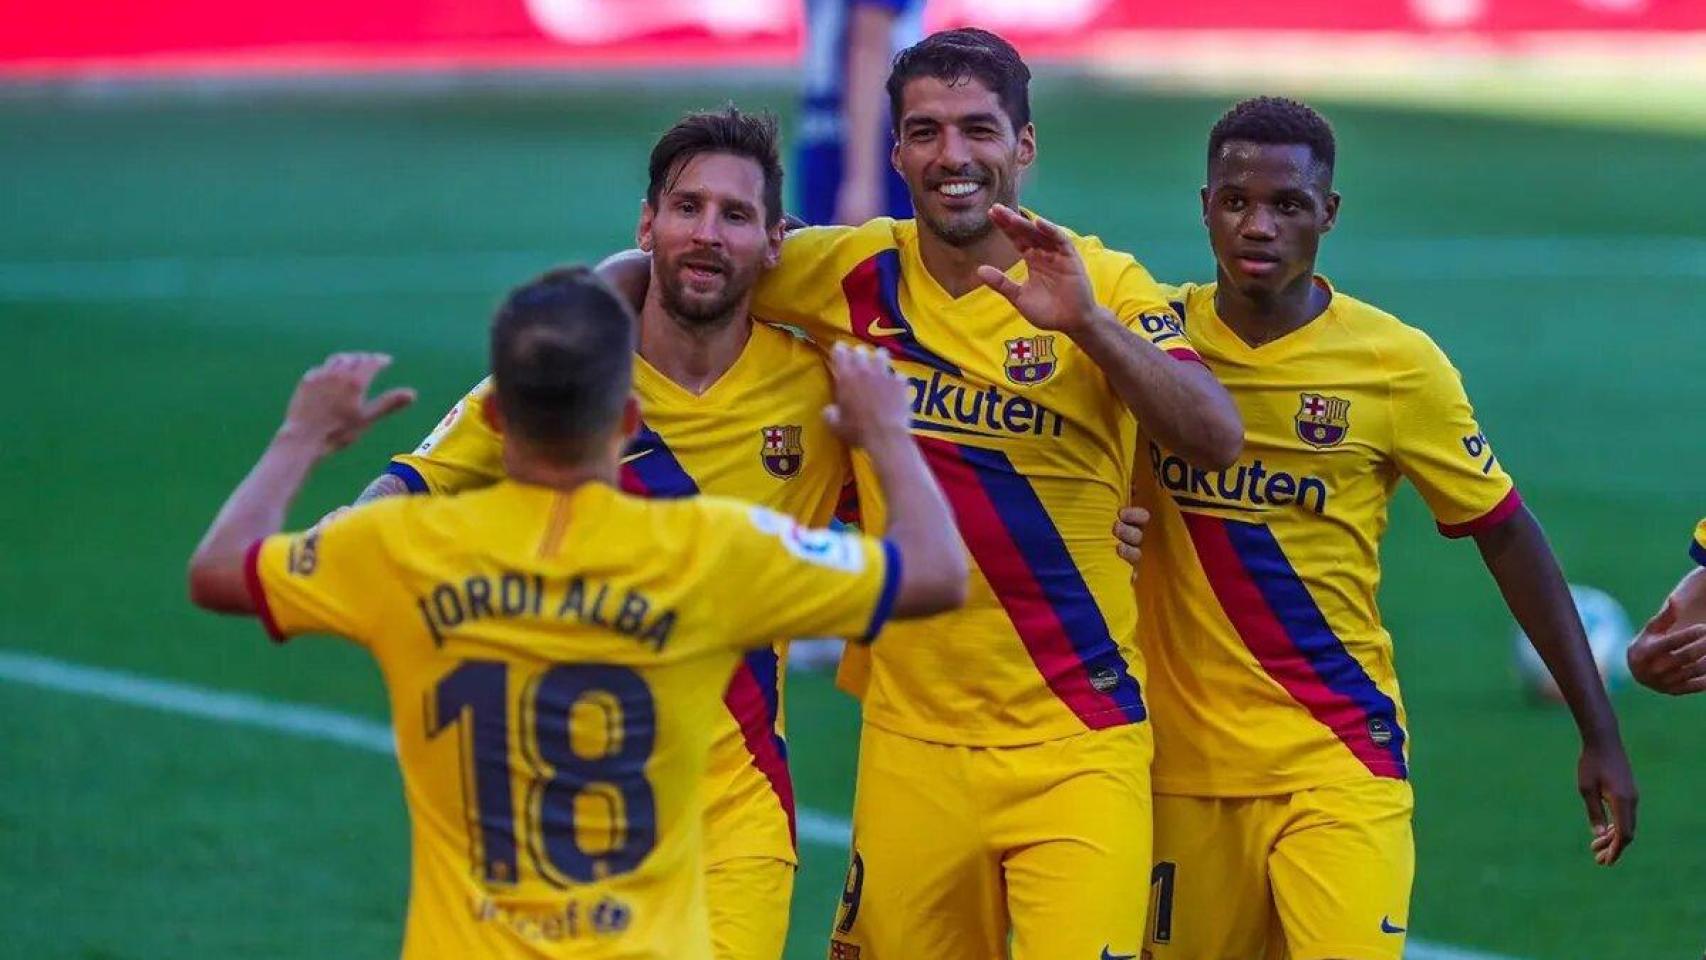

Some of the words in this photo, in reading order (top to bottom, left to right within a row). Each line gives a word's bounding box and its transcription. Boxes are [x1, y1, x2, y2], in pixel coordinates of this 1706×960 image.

[908, 371, 1064, 437] akuten
[418, 573, 543, 648] JORDI
[558, 574, 677, 651] ALBA
[421, 659, 659, 889] 18
[836, 851, 864, 933] 9
